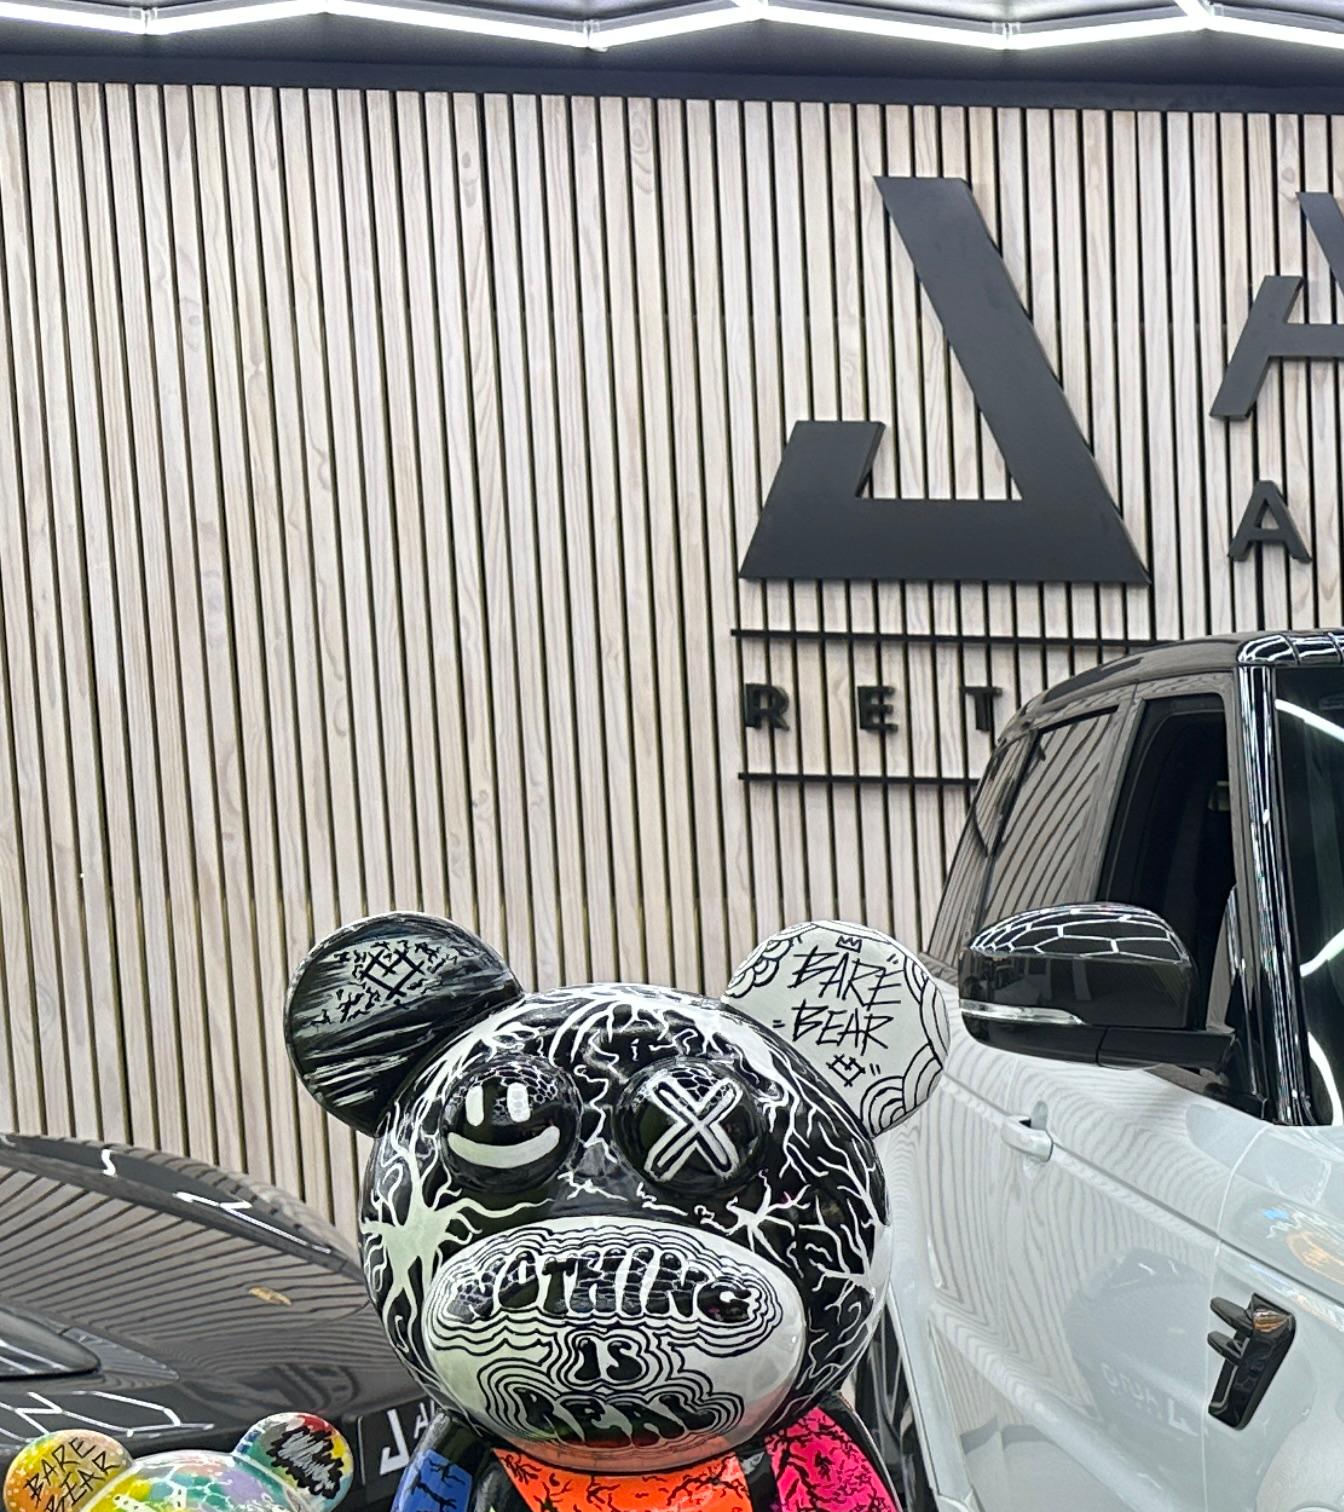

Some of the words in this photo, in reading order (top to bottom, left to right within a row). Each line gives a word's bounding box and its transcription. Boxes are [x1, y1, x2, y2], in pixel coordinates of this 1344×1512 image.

[744, 681, 1003, 733] RET
[787, 945, 904, 1012] BARE
[791, 998, 895, 1056] BEAR
[445, 1247, 752, 1324] NOTHING
[573, 1336, 646, 1383] IS
[512, 1387, 717, 1449] REAL
